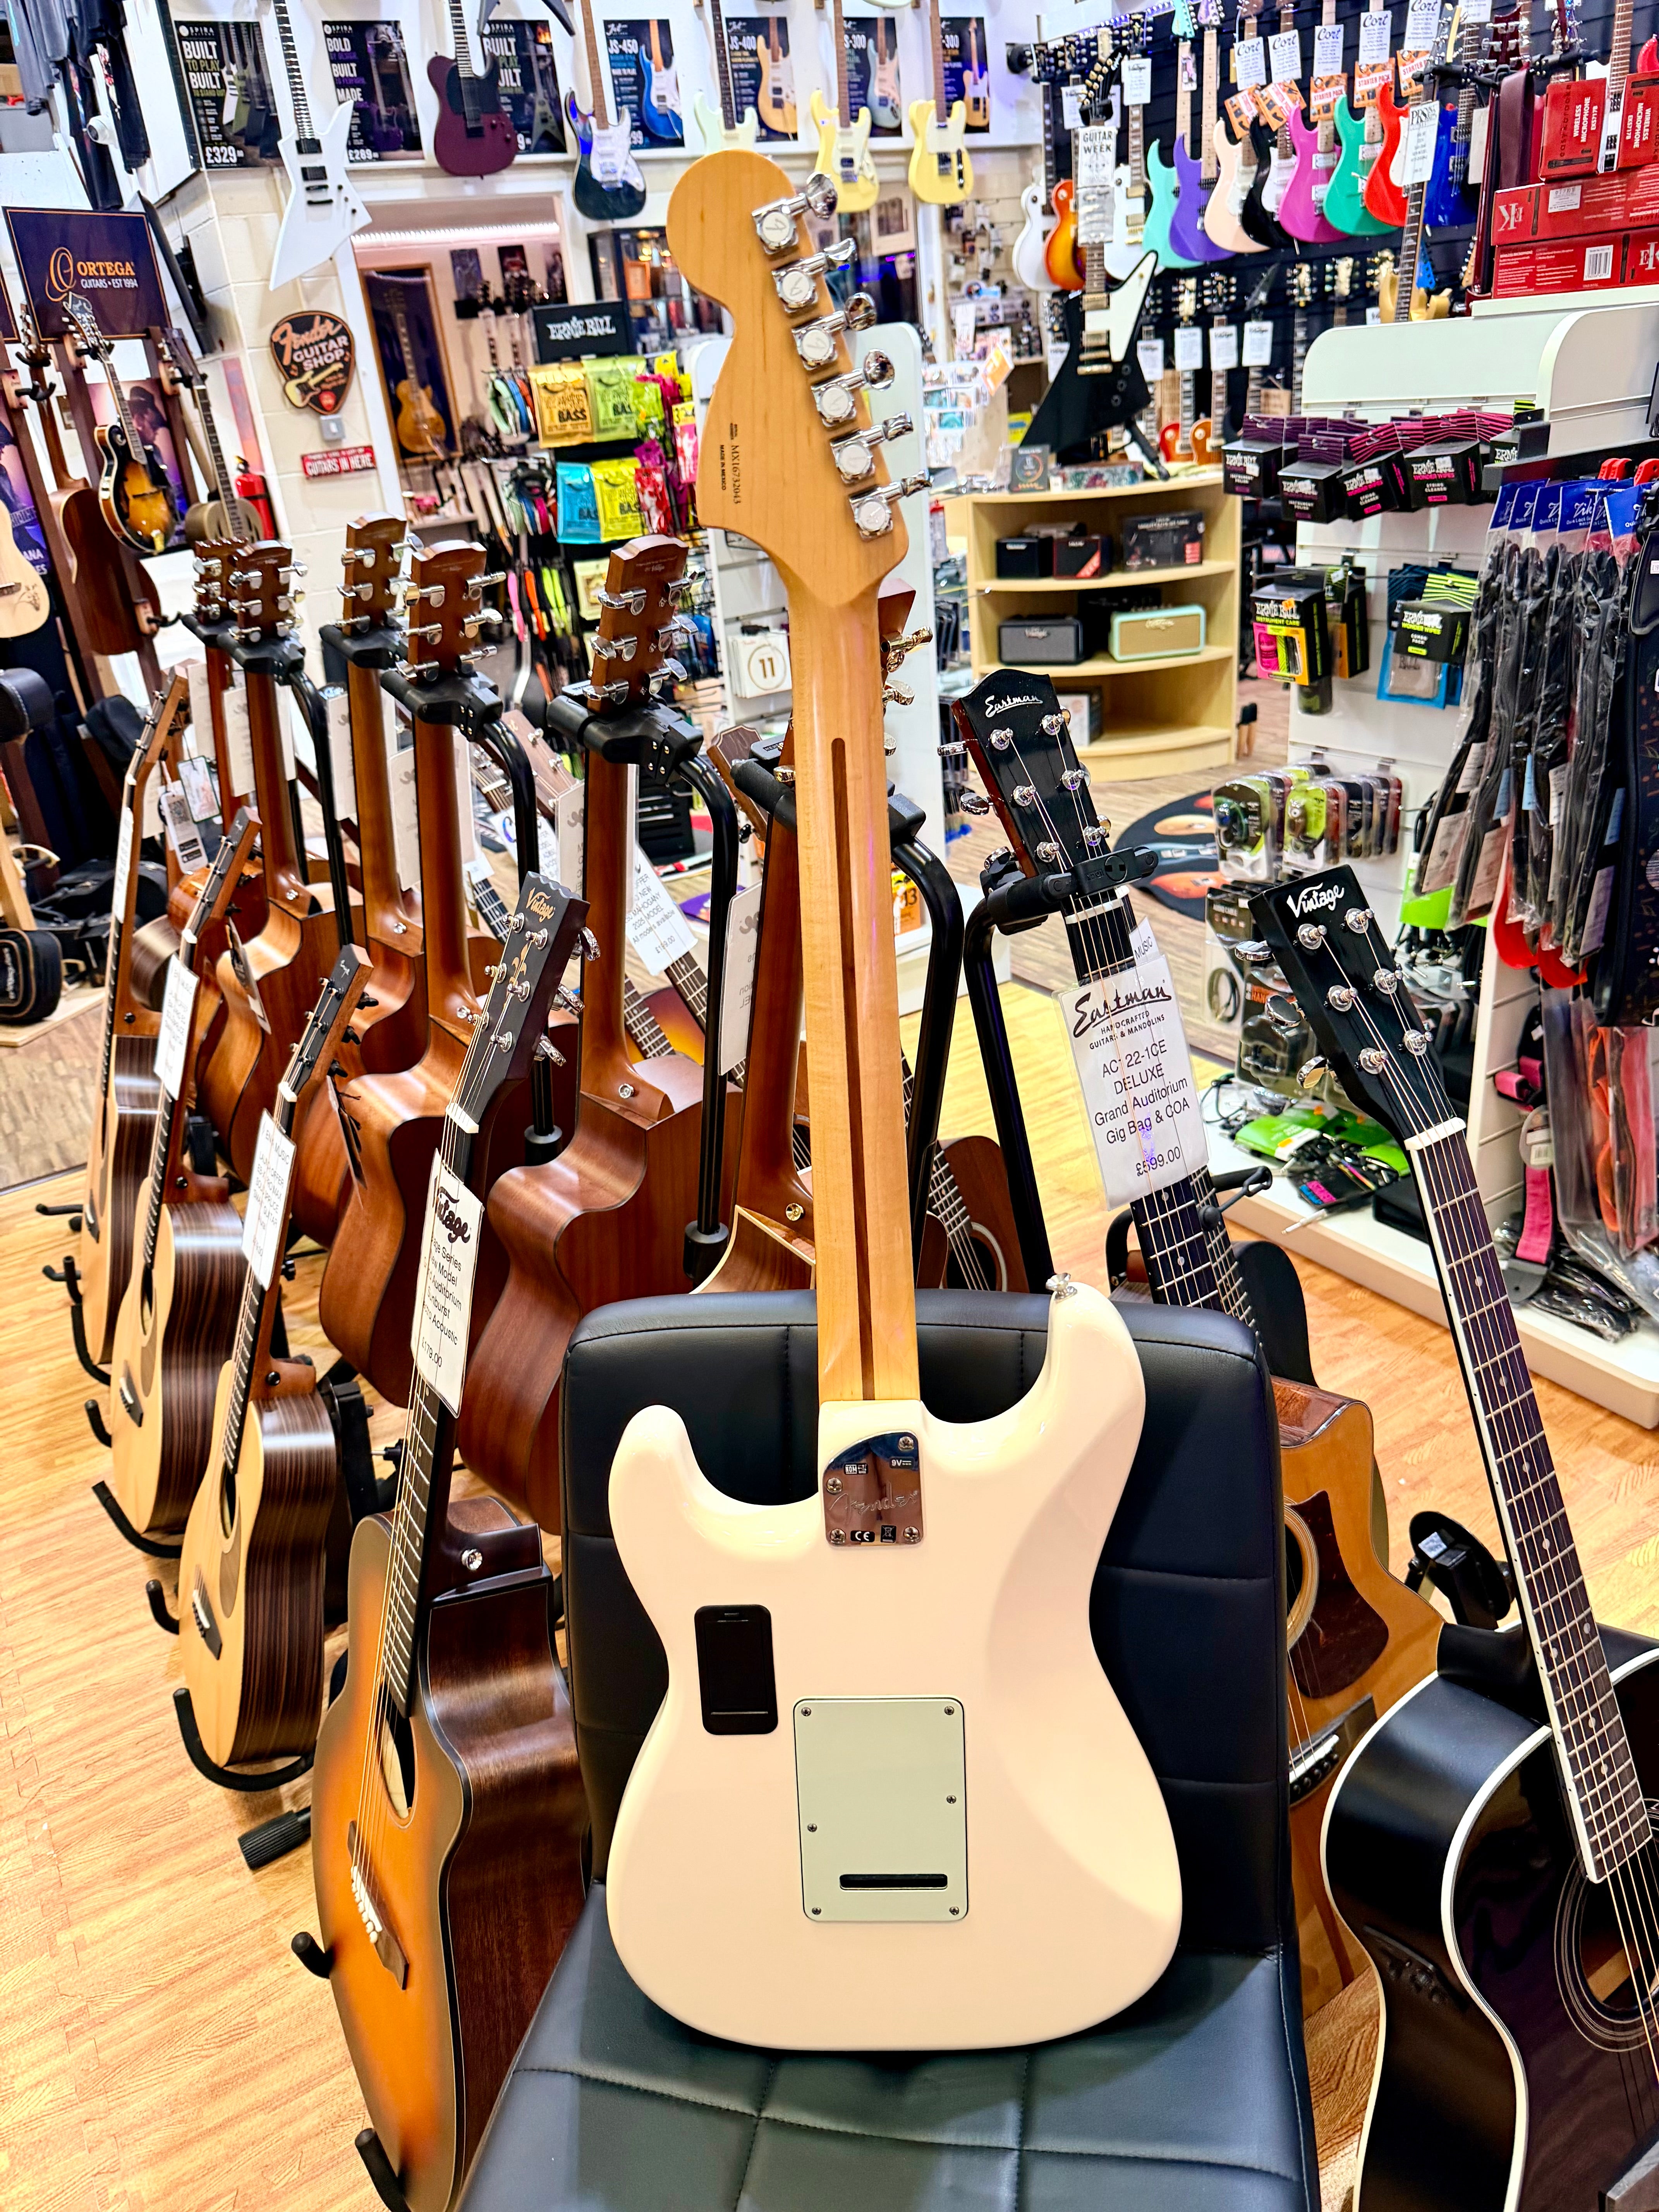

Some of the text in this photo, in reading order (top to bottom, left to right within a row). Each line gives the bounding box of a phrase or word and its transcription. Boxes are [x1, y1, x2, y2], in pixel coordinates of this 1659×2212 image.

[1363, 14, 1388, 27] Cort
[326, 38, 351, 52] BOLD
[730, 36, 756, 50] JS-400
[844, 34, 866, 49] S-300
[1273, 34, 1297, 50] Cort
[1317, 28, 1341, 41] Cort
[182, 41, 218, 59] BUILT
[608, 40, 638, 54] JS-450
[1237, 41, 1260, 56] Cort
[186, 60, 220, 71] TO PLAY
[331, 63, 357, 77] BUILT
[1403, 63, 1424, 75] STARTER
[189, 72, 221, 89] BUILT
[498, 69, 521, 87] UILT
[1358, 77, 1377, 87] STARTER
[337, 88, 364, 101] MADE
[1573, 105, 1582, 137] WIRELESS
[1581, 97, 1590, 142] MICROPHONE
[1633, 103, 1644, 148] MICROPHONE
[1642, 108, 1651, 141] WIRELESS
[1083, 131, 1112, 143] GUITAR
[1084, 144, 1111, 154] WEEK
[77, 262, 135, 276] ORTEGA
[81, 278, 139, 289] GUITARS EST 1994
[585, 316, 616, 336] BALL
[272, 316, 342, 365] Fender
[293, 335, 349, 362] GUITAR
[302, 349, 344, 371] SHOP
[558, 408, 587, 422] BASS
[1255, 600, 1278, 617] ERNIE
[1256, 616, 1285, 625] INSTRUMENT
[1401, 622, 1442, 635] WONDER WIPES
[759, 657, 775, 679] 11
[985, 695, 1043, 718] Eastman
[639, 885, 652, 898] NEW
[1287, 883, 1344, 917] Vintage
[526, 887, 555, 923] Vintage
[632, 891, 661, 915] MAHOGANY
[632, 905, 664, 930] 2025 MODEL
[1135, 936, 1153, 960] MUSIC
[1073, 987, 1172, 1038] Eastman
[1101, 1010, 1149, 1034] HANDCRAFTED
[1089, 1034, 1118, 1049] GUITARS
[1128, 1014, 1165, 1036] MANDOLINS
[1103, 1039, 1167, 1078] AC22-1CE
[1114, 1063, 1164, 1095] DELUXE
[1095, 1078, 1188, 1126] Grand Auditorium
[1106, 1097, 1190, 1144] Gig Bag & COA
[275, 1143, 290, 1165] MUSIC
[1136, 1146, 1181, 1177] £599.00
[433, 1175, 471, 1243] Vintage
[442, 1247, 462, 1272] Series
[439, 1262, 458, 1287] Model
[428, 1286, 450, 1319] Sunburst
[432, 1274, 462, 1312] Auditorium
[432, 1314, 458, 1346] Acoustic
[422, 1336, 442, 1368] £179.00
[845, 1464, 857, 1474] NOM
[829, 1481, 918, 1526] Fender
[855, 1531, 870, 1541] CE
